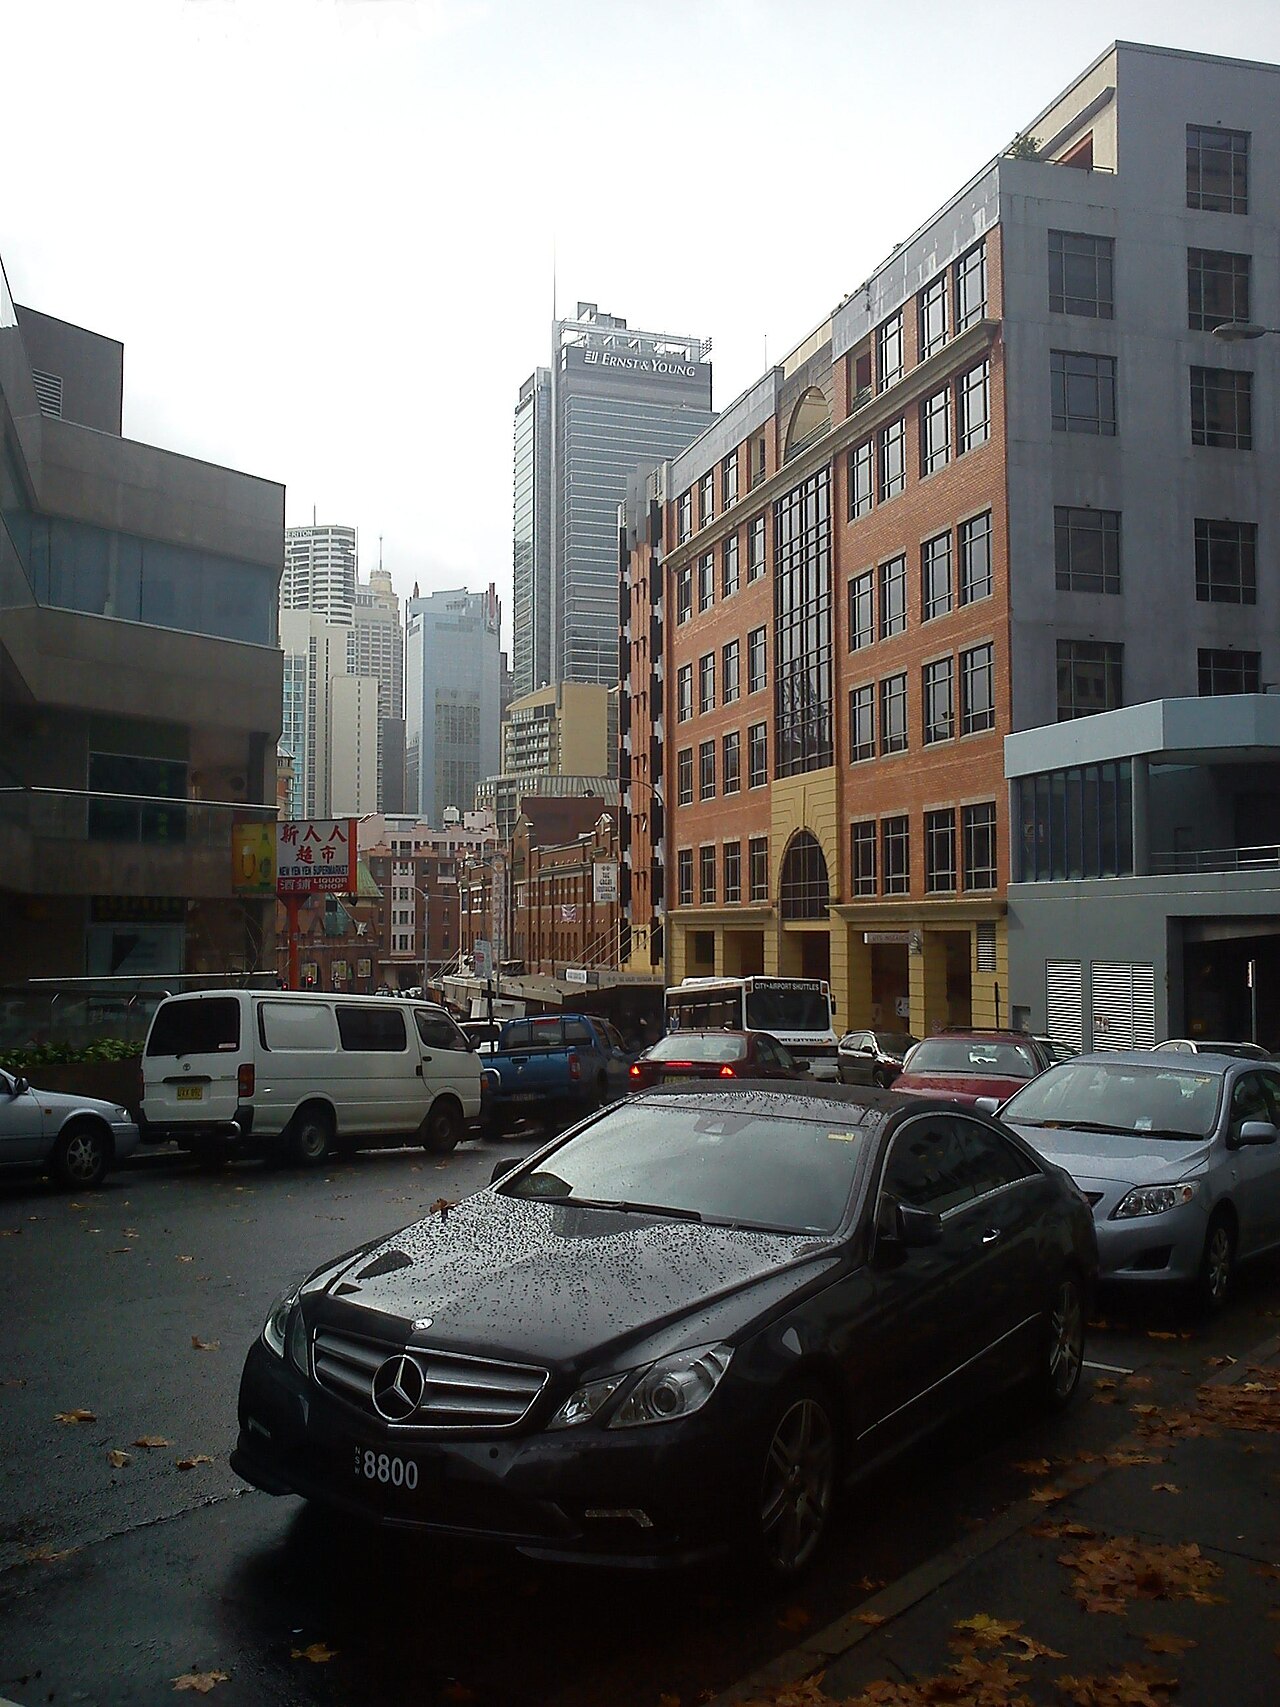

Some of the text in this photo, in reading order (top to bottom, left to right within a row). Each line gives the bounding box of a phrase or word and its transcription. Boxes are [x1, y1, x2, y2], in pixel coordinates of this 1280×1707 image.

[601, 353, 638, 369] ERNST
[640, 361, 650, 371] &
[650, 359, 696, 377] YOUNG
[285, 530, 313, 538] ERITON
[280, 823, 348, 846] 新人人
[295, 845, 337, 864] 超市
[312, 864, 348, 876] SUPERMARKET
[792, 983, 820, 991] SHUTTLES
[364, 1450, 418, 1490] 8800
